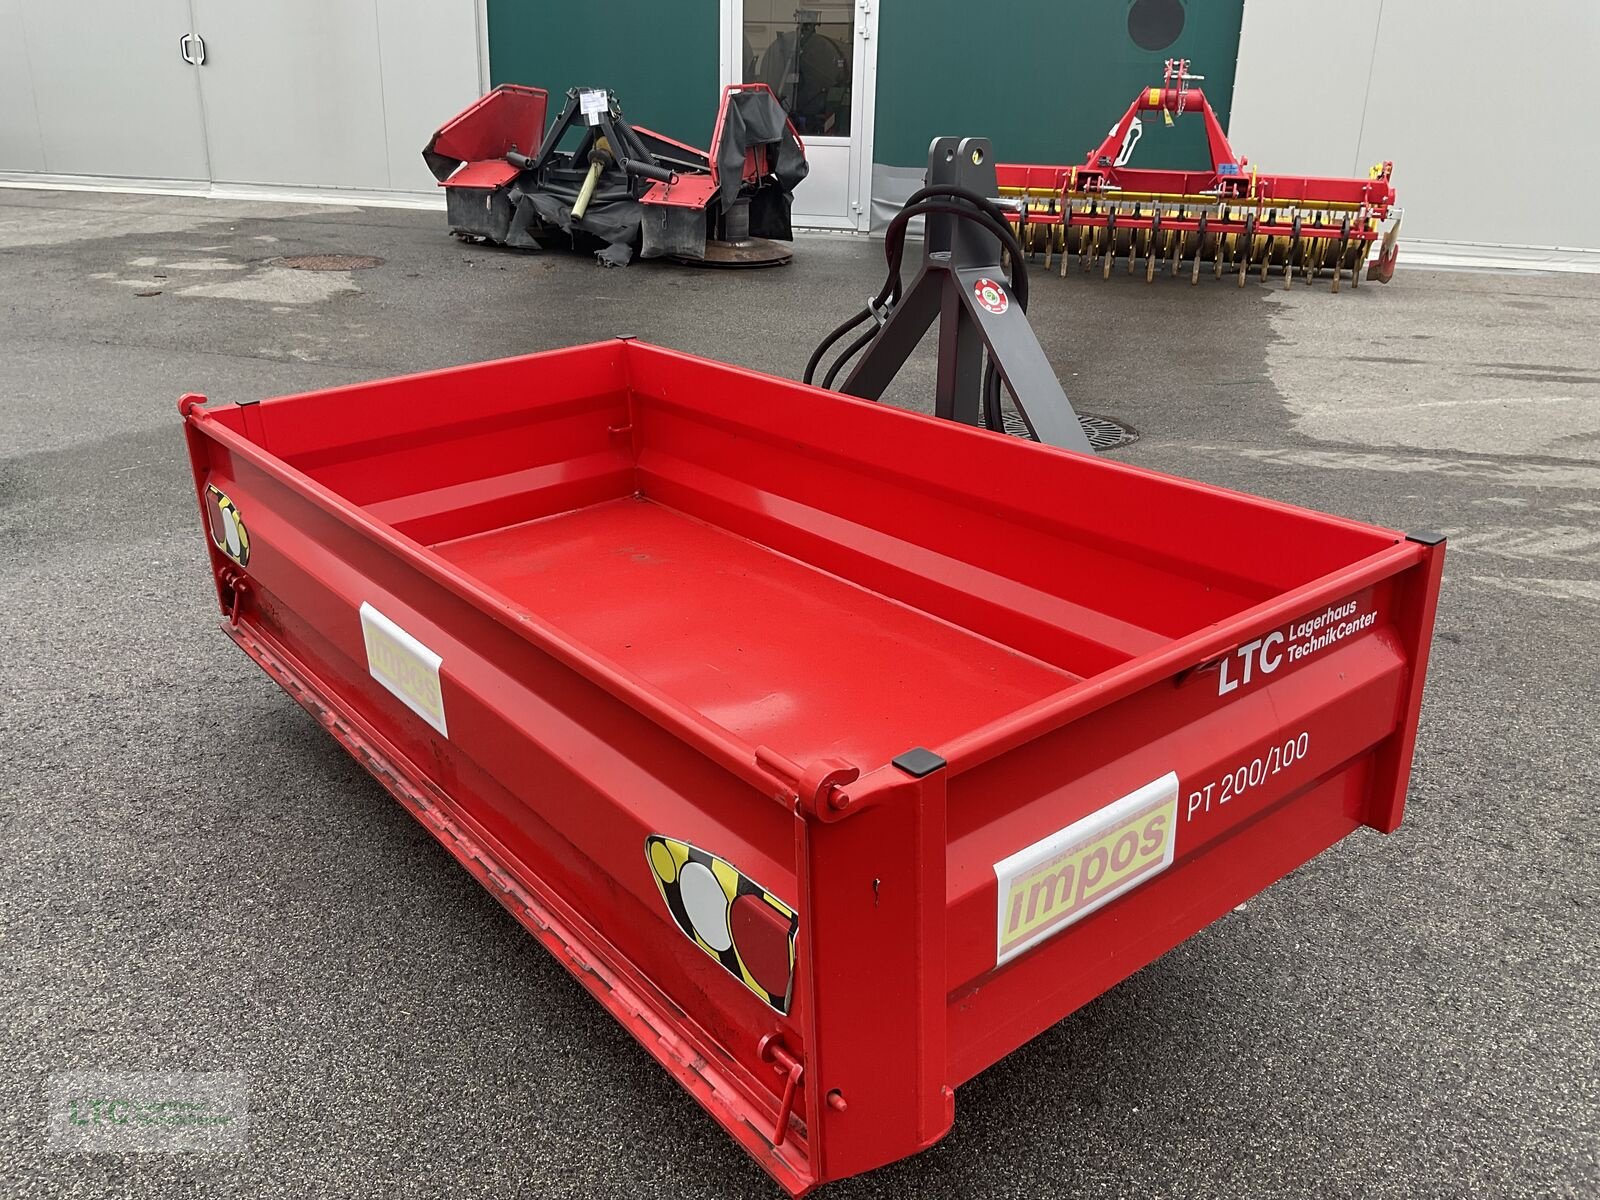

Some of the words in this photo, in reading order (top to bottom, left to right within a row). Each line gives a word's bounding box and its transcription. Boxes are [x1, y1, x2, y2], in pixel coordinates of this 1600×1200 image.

[1287, 610, 1378, 663] TechnikCenter
[1288, 600, 1358, 641] Lagerhaus
[1218, 631, 1285, 696] LTC
[1187, 782, 1216, 822] PT
[1219, 731, 1309, 804] 200/100
[1008, 814, 1167, 934] impos
